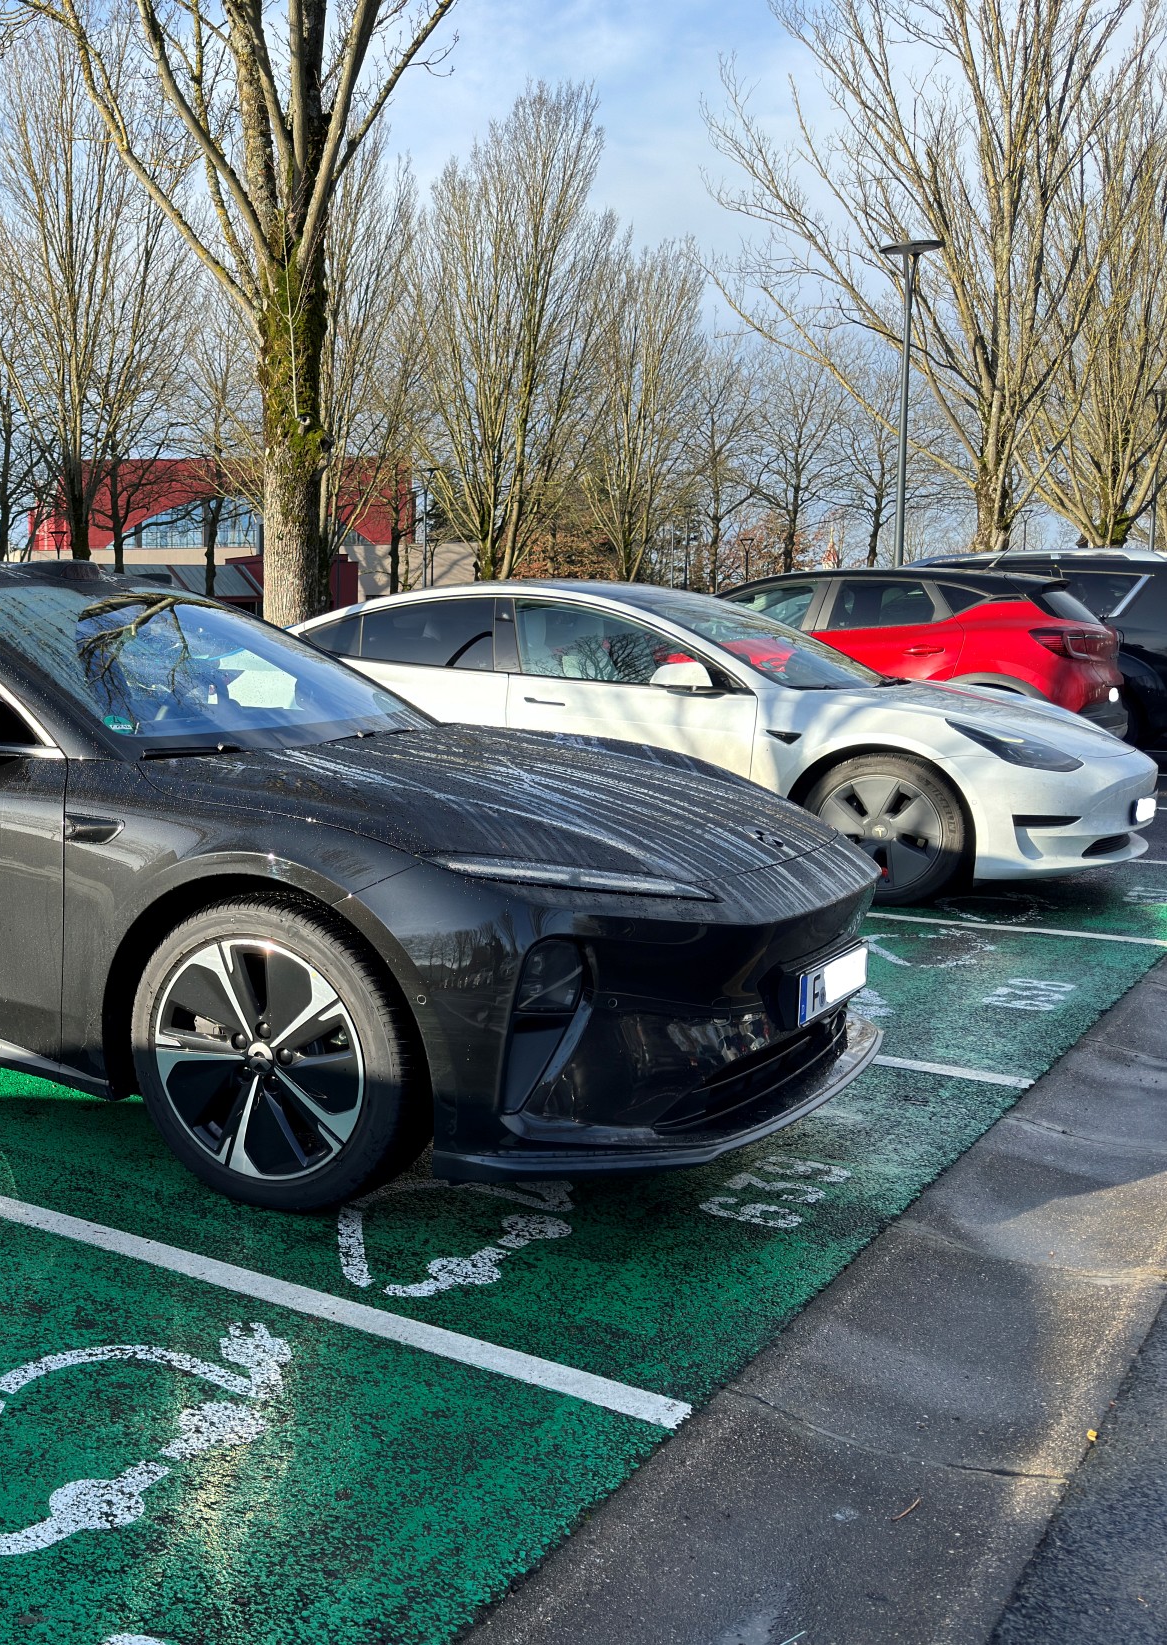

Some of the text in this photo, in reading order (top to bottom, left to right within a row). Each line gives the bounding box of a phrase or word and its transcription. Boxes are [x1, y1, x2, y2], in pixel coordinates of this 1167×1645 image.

[924, 781, 957, 836] MICHELIN
[981, 978, 1077, 1011] 638
[698, 1155, 852, 1228] 639
